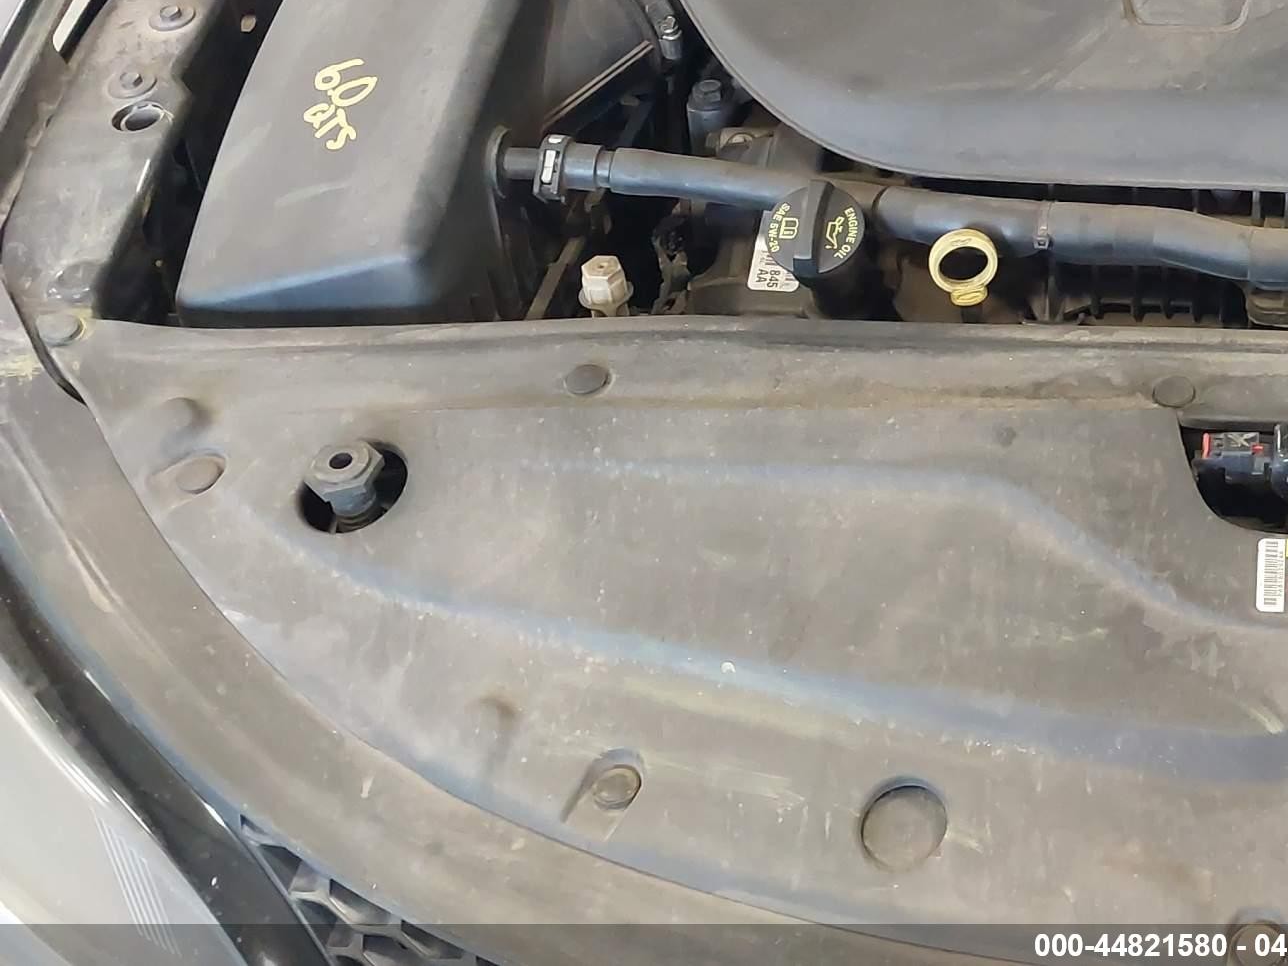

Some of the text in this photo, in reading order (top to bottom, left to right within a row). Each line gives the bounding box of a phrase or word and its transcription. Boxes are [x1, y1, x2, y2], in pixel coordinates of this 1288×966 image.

[767, 202, 791, 253] SAE 5W-20
[833, 206, 859, 259] ENGINE OIL
[755, 268, 767, 283] AA
[766, 269, 781, 288] 845
